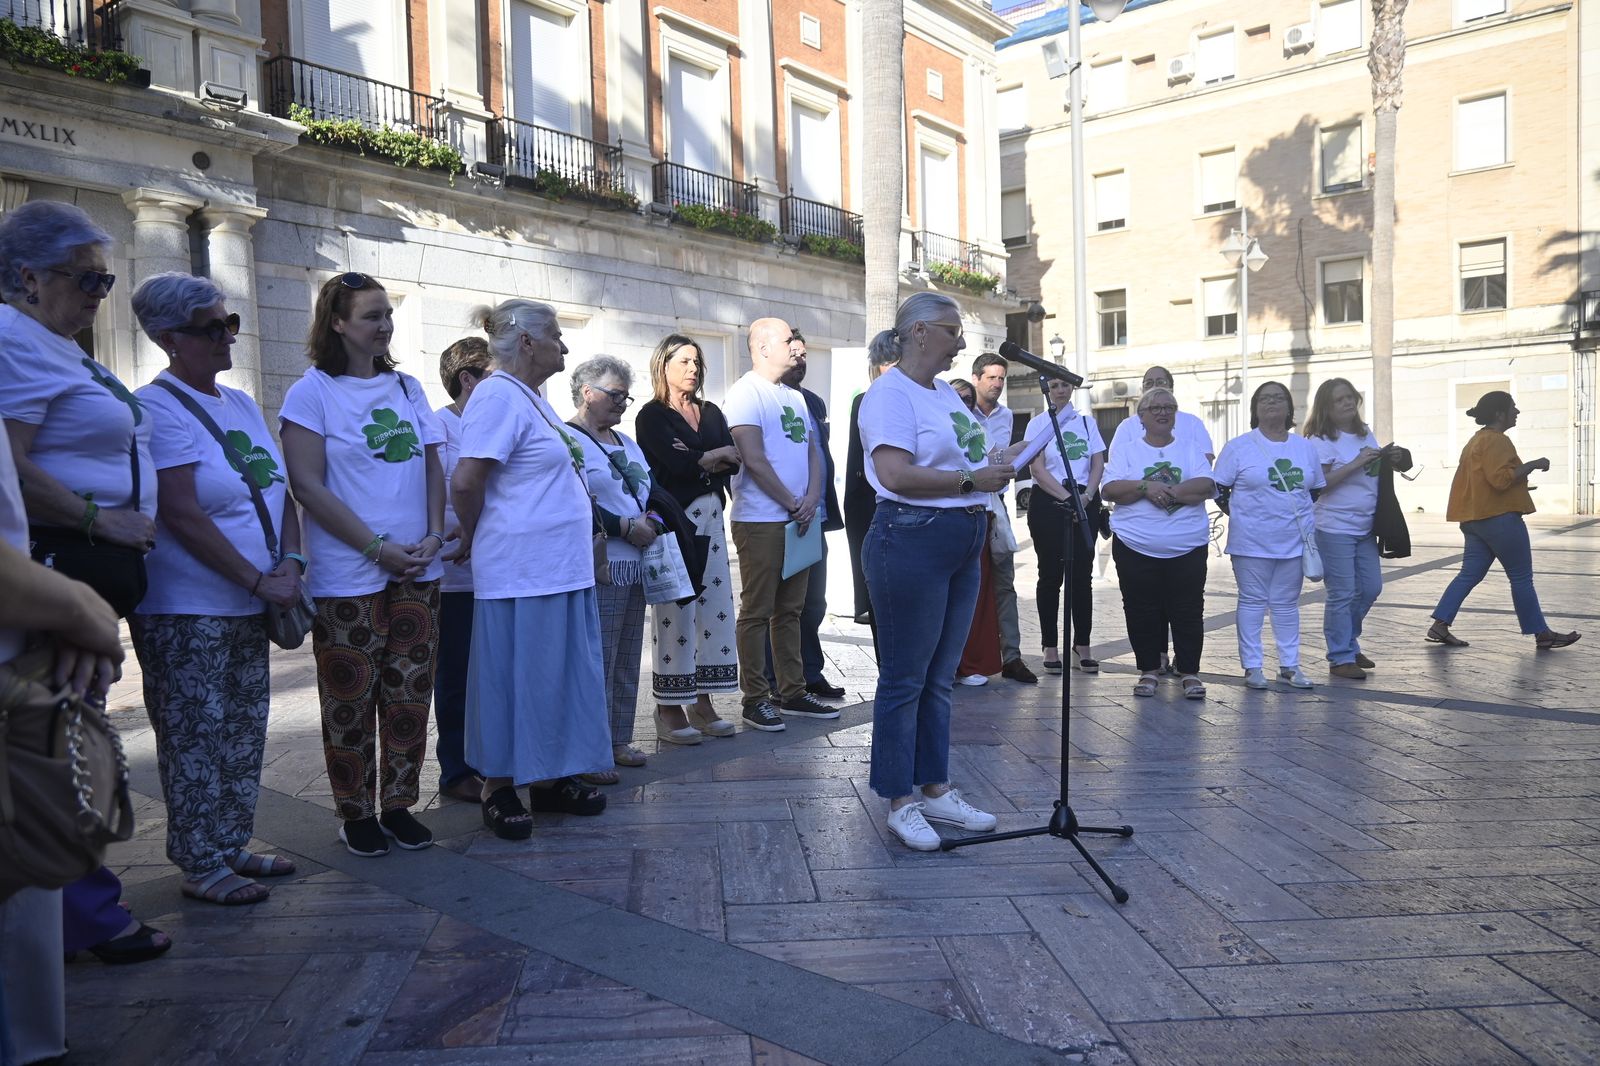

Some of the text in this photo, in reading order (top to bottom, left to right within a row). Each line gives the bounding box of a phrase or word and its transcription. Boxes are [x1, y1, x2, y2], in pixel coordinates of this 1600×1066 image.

[0, 116, 77, 146] MXLIX
[373, 426, 414, 446] FIBRONUBA
[242, 452, 270, 464] ONUBA
